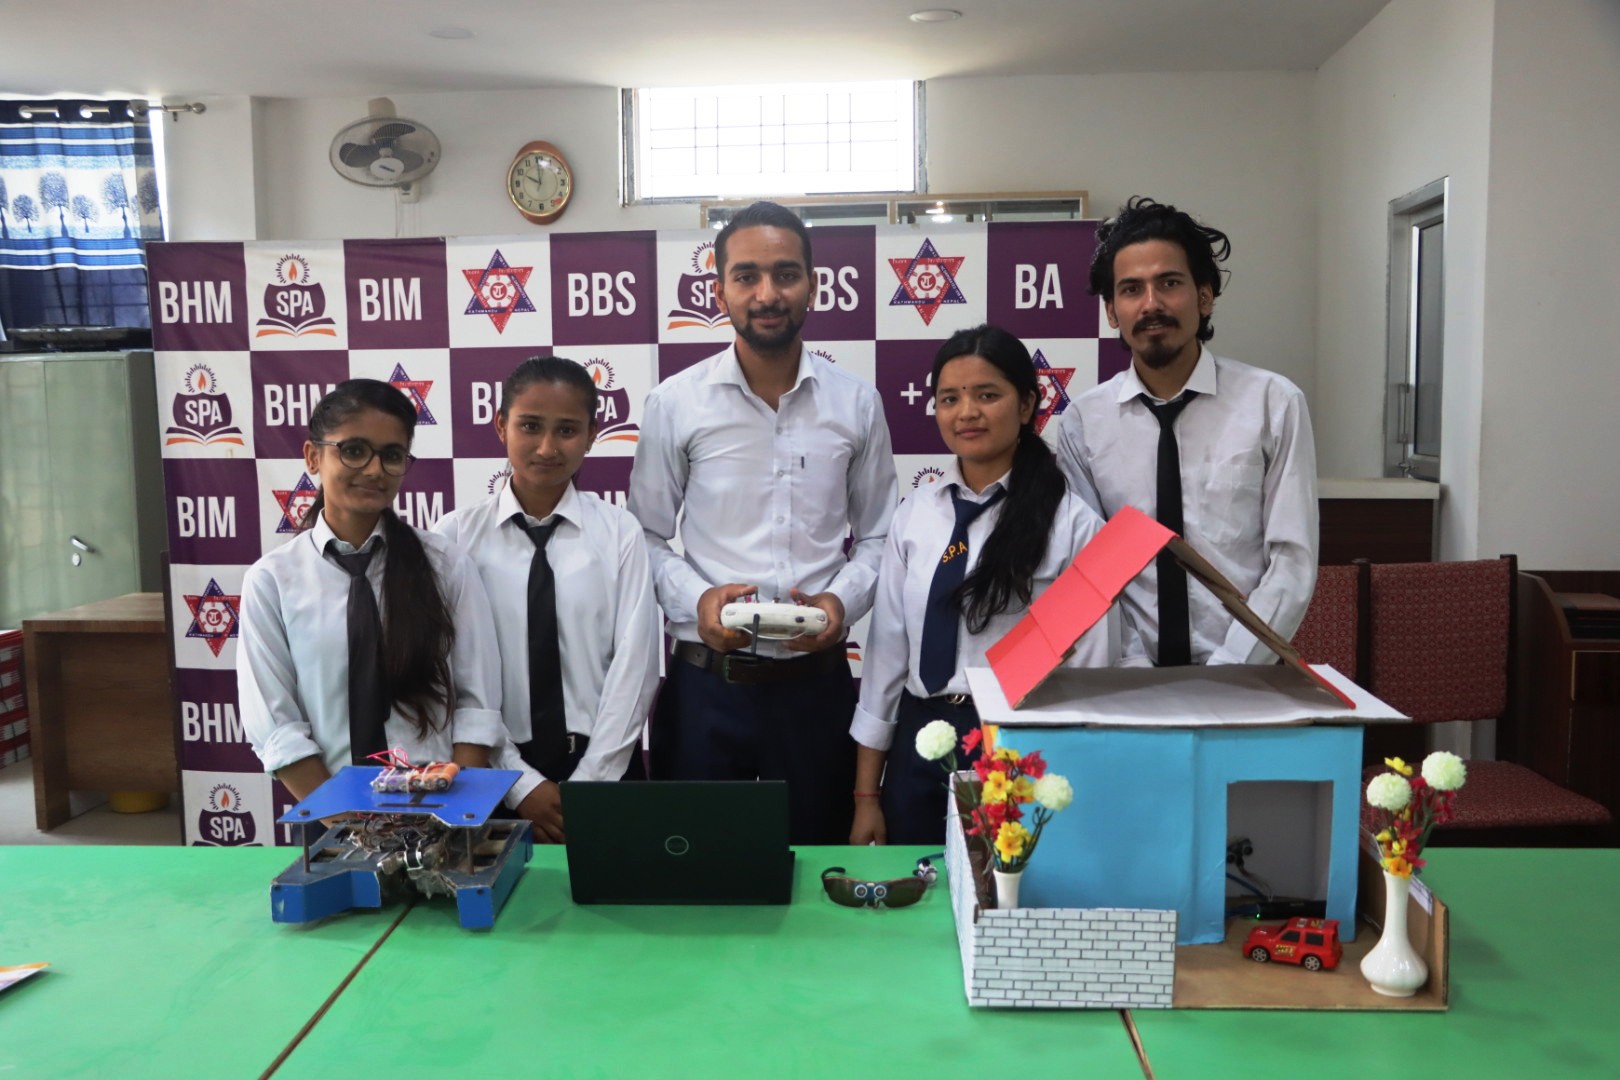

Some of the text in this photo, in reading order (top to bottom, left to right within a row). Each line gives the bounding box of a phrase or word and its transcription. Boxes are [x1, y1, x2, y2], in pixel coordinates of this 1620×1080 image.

[158, 281, 233, 323] BHM
[275, 290, 315, 318] SPA
[359, 277, 422, 321] BIM
[567, 270, 637, 317] BBS
[691, 279, 716, 309] SP
[806, 265, 859, 312] BS
[1014, 263, 1064, 309] BA
[184, 399, 223, 427] SPA
[594, 394, 618, 423] PA
[176, 495, 237, 538] BIM
[393, 491, 443, 530] HM
[209, 816, 246, 842] SPA
